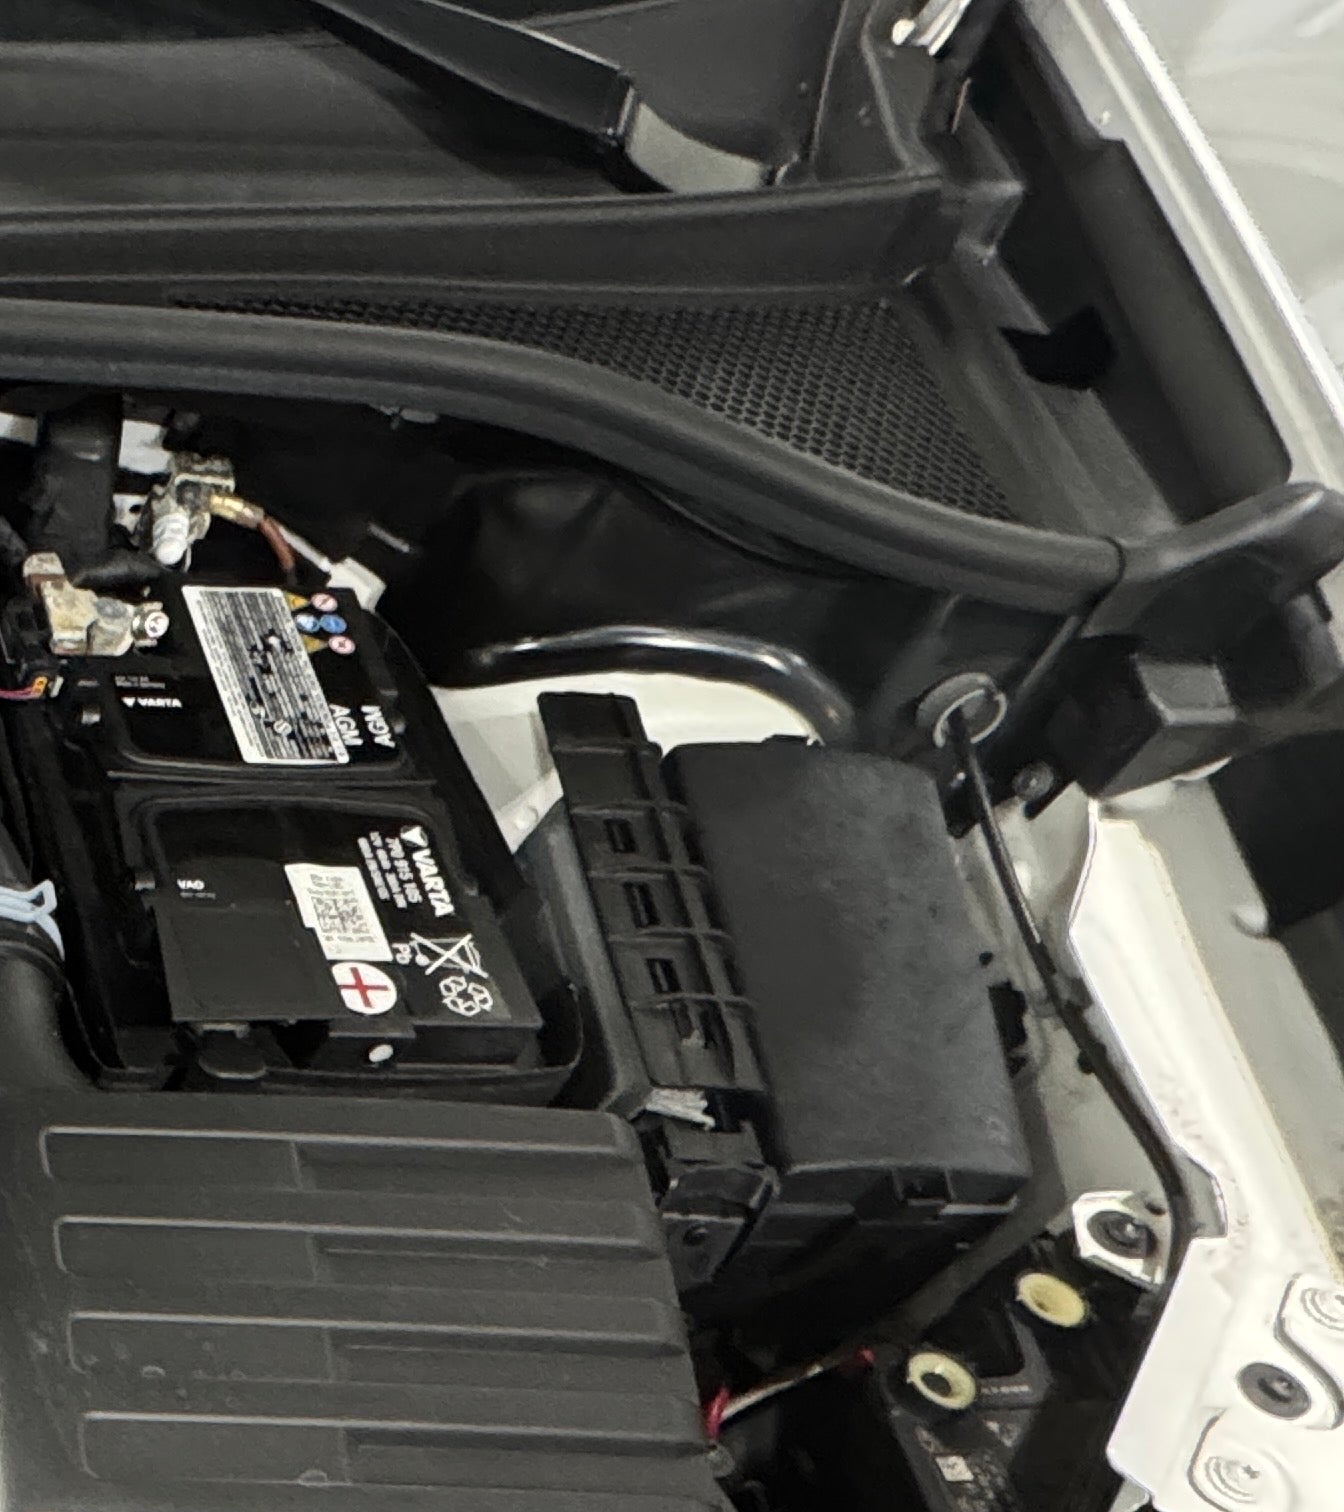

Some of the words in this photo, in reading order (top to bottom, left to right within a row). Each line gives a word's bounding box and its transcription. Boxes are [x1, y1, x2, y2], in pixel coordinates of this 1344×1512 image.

[137, 697, 182, 708] VARTA
[329, 703, 363, 746] AGM
[361, 705, 395, 749] AGM
[413, 848, 455, 917] VARTA
